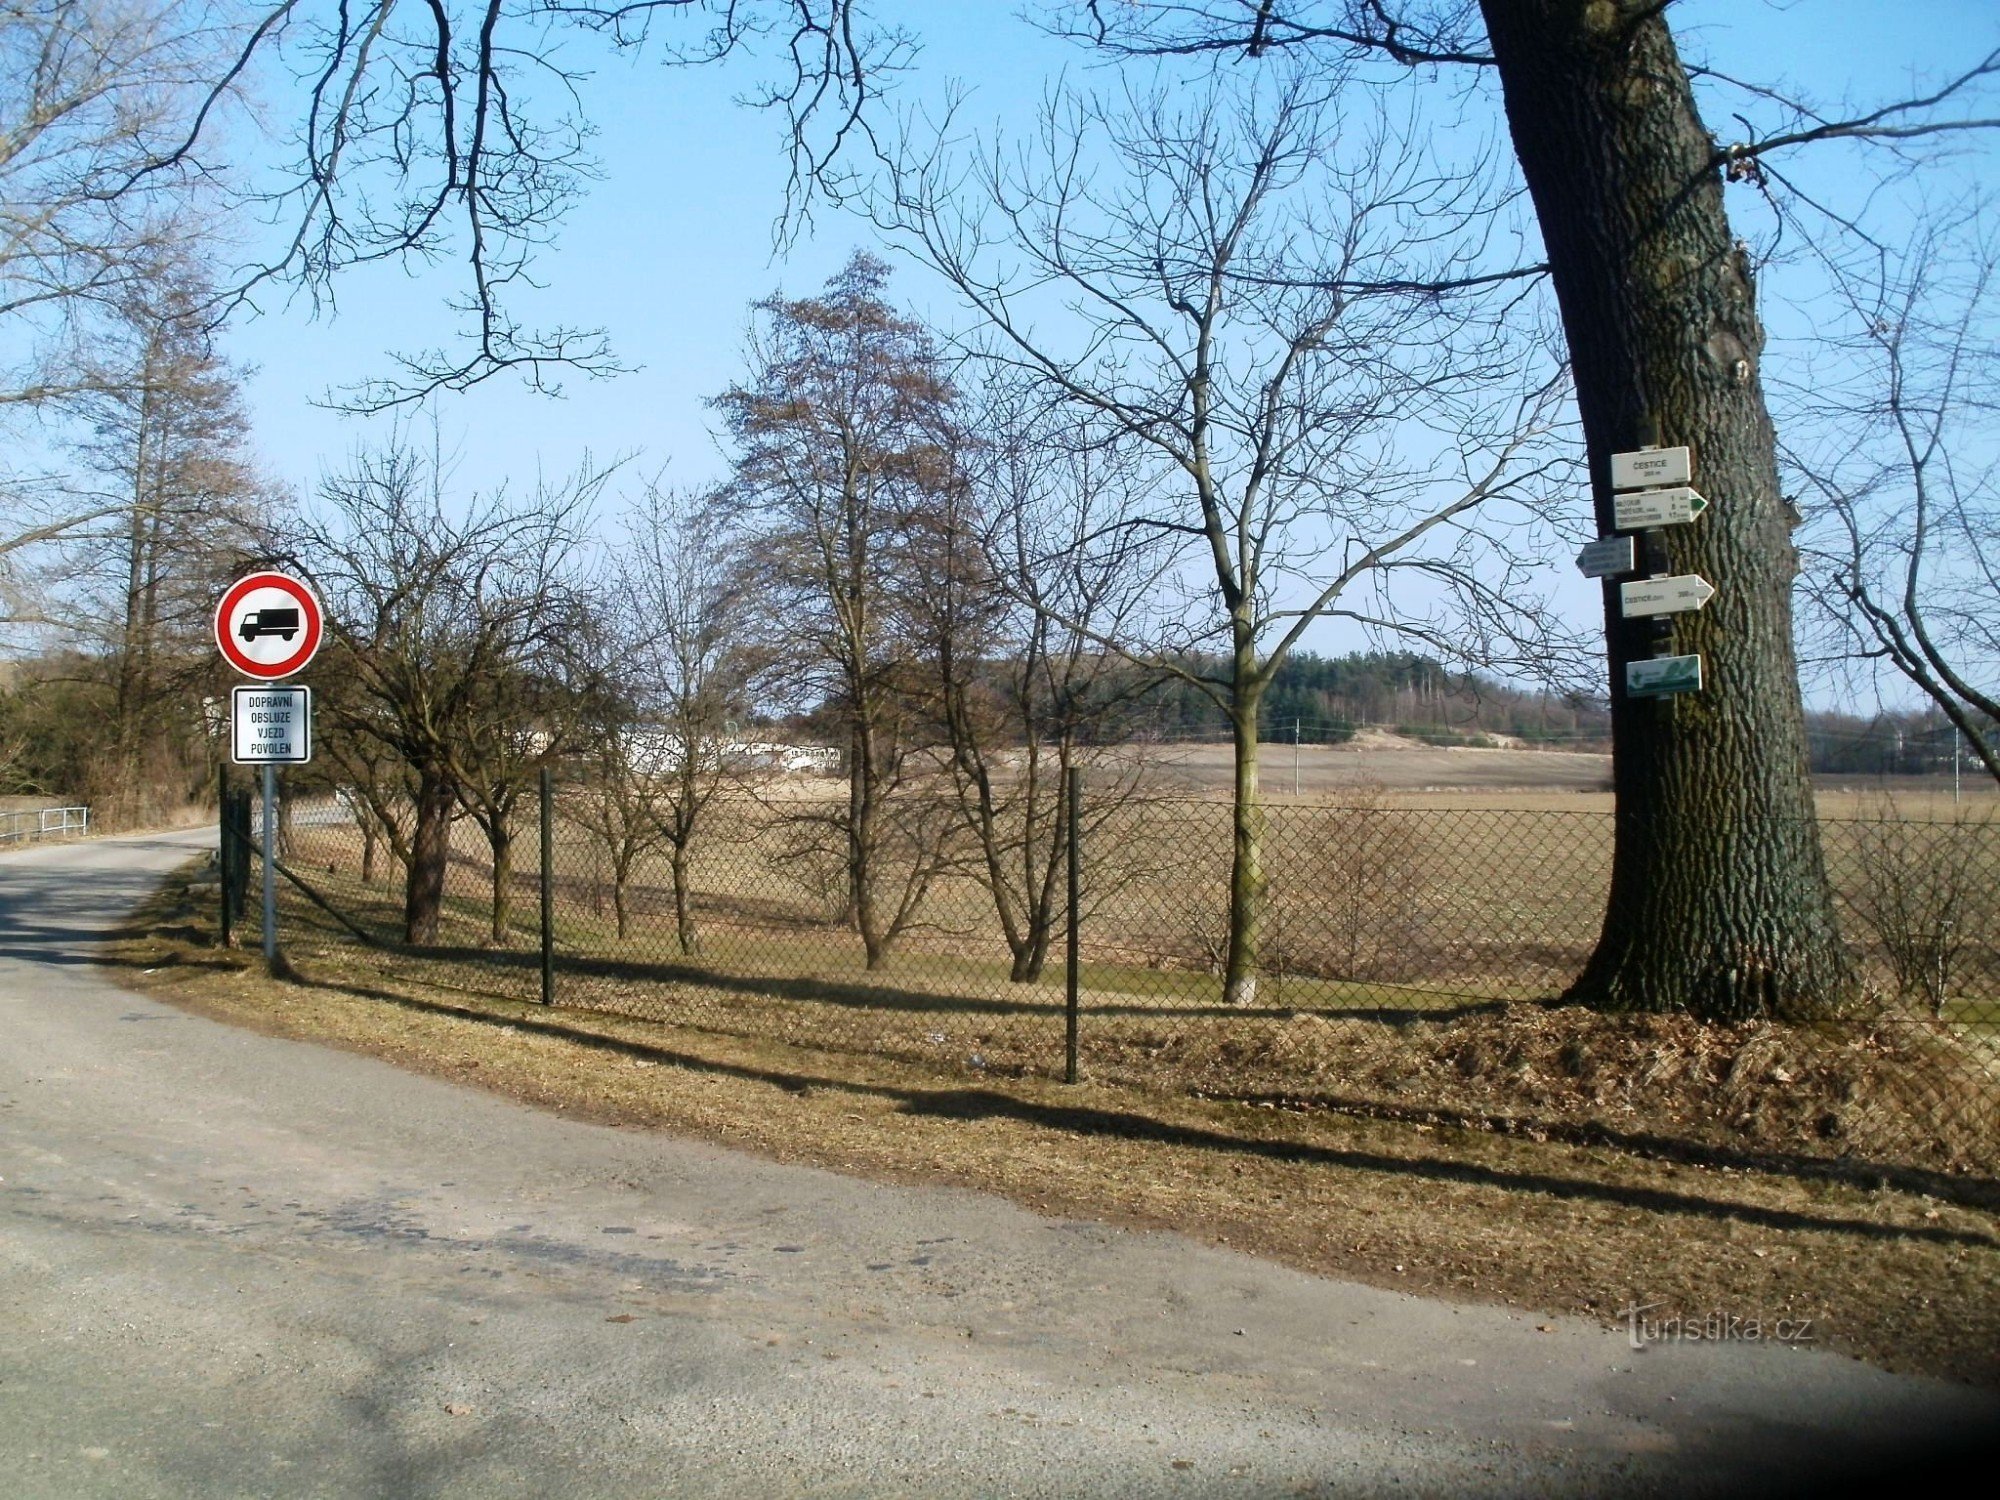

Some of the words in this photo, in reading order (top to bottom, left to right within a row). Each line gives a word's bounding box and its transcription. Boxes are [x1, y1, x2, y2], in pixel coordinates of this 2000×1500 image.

[249, 694, 293, 708] DOPRAVNÍ
[251, 712, 291, 724] OBSLUZE
[257, 727, 285, 739] VJEZD
[251, 742, 292, 755] POVOLEN
